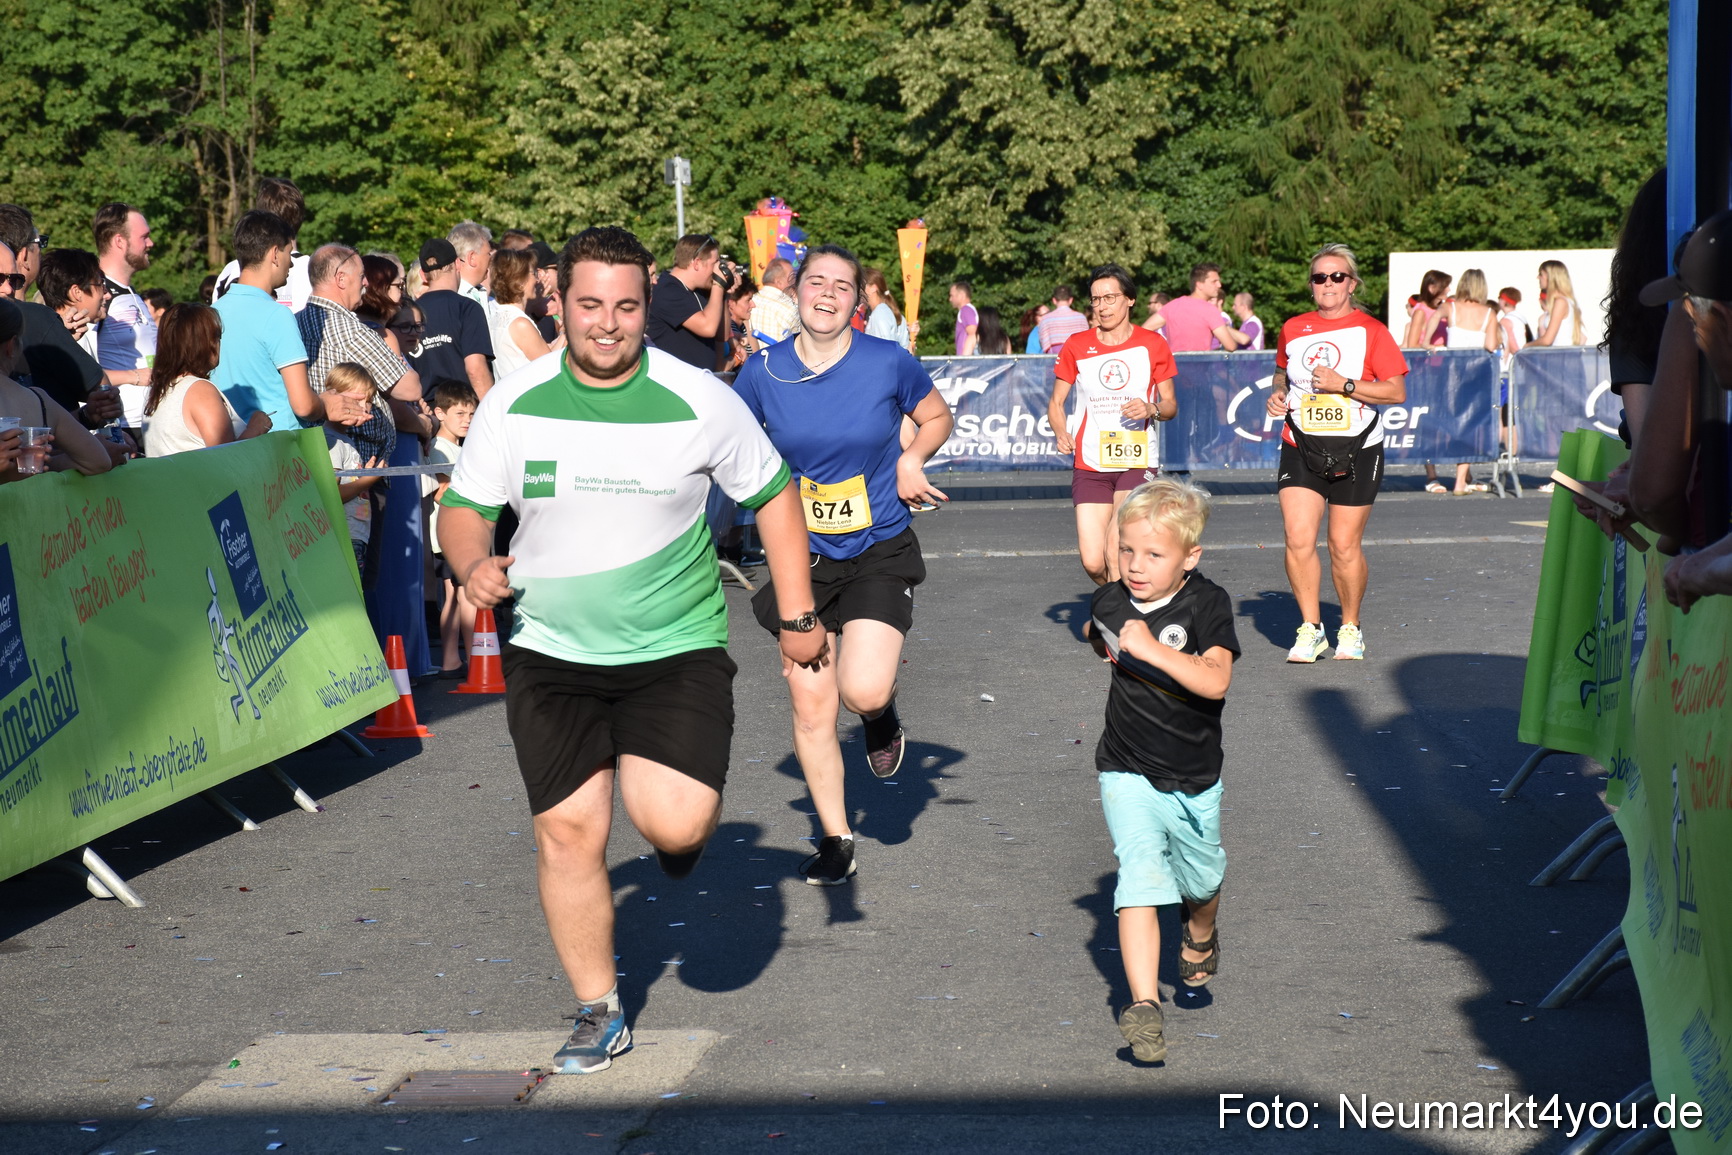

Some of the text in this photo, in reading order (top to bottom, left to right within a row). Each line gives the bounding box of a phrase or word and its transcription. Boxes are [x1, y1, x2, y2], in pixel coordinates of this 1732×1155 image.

[1306, 407, 1344, 422] 1568
[934, 441, 1066, 456] AUTOMOBIL
[1105, 443, 1142, 458] 1569
[524, 472, 555, 486] BayWa
[574, 475, 642, 487] BayWa Baustoffe
[574, 484, 677, 497] Immer ein gutes Baugefühl
[812, 499, 853, 520] 674
[226, 531, 248, 560] Fischer
[69, 564, 114, 626] laufen
[232, 569, 308, 684] firmenlauf
